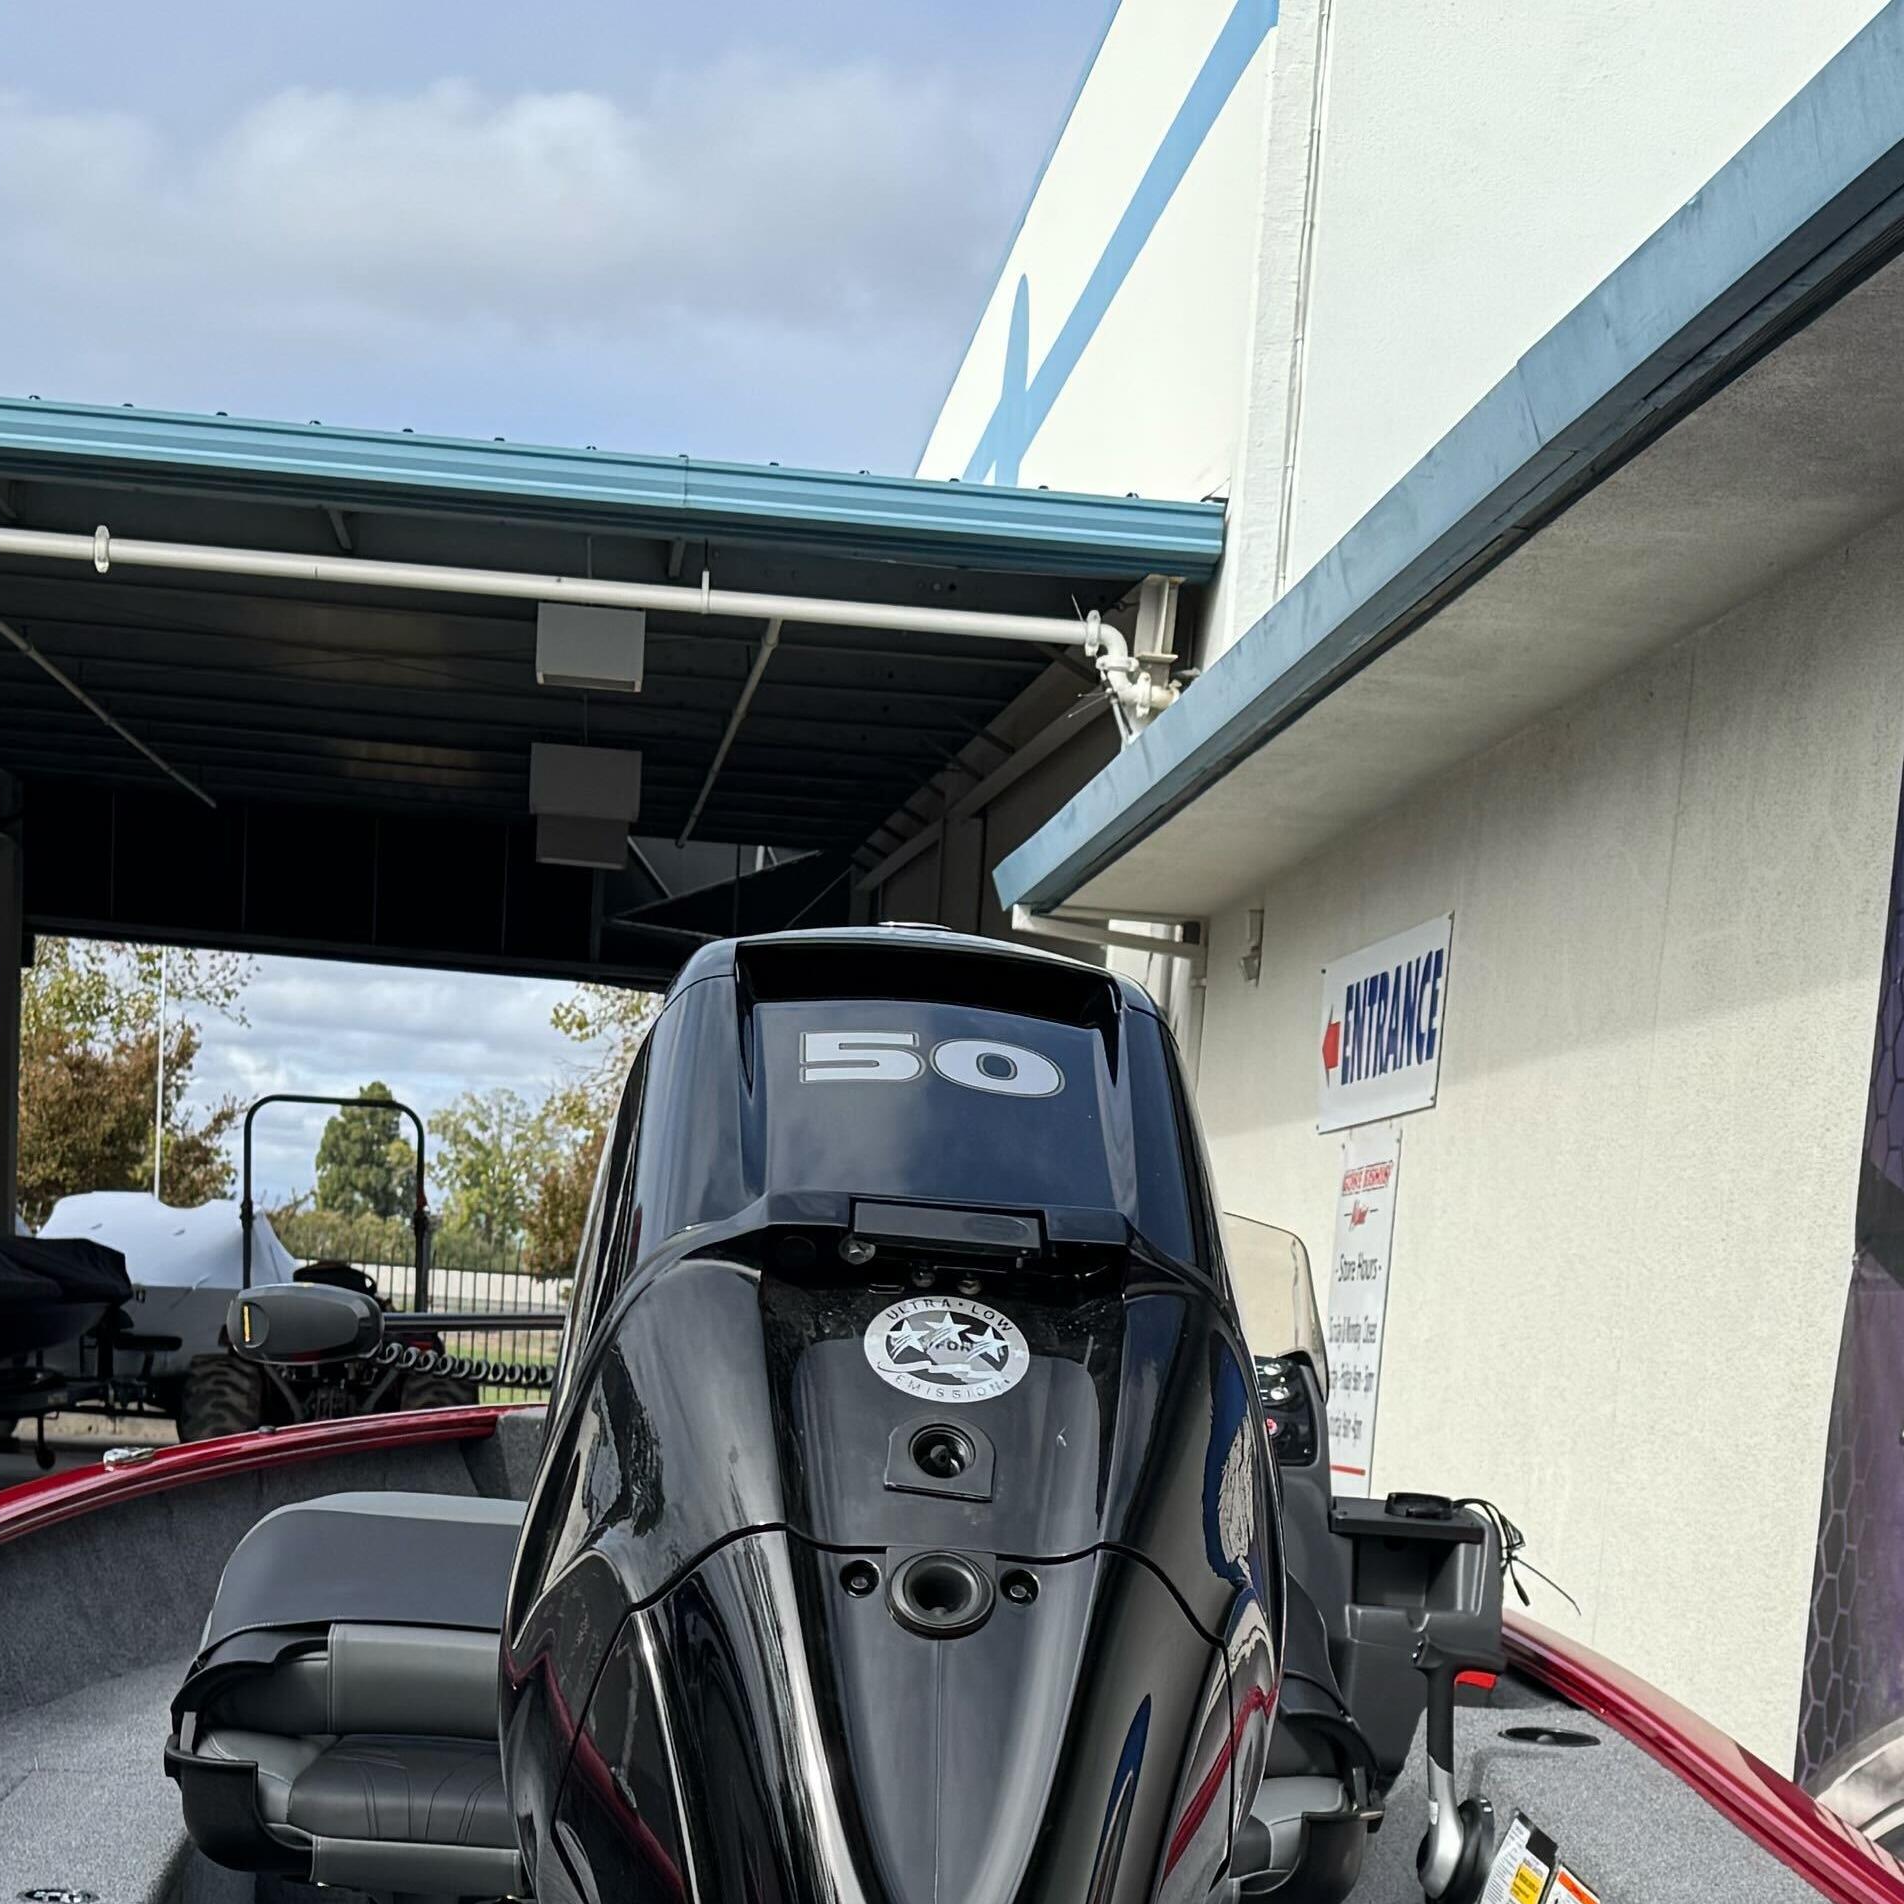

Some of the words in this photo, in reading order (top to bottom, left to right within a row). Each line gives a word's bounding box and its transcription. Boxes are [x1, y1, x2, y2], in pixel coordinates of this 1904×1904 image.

[1340, 948, 1444, 1086] ENTRANCE
[799, 1031, 1066, 1098] 50
[1338, 1253, 1356, 1282] Store
[1357, 1252, 1378, 1280] Hours
[886, 1298, 950, 1320] ULTRA
[971, 1305, 1012, 1332] LOW
